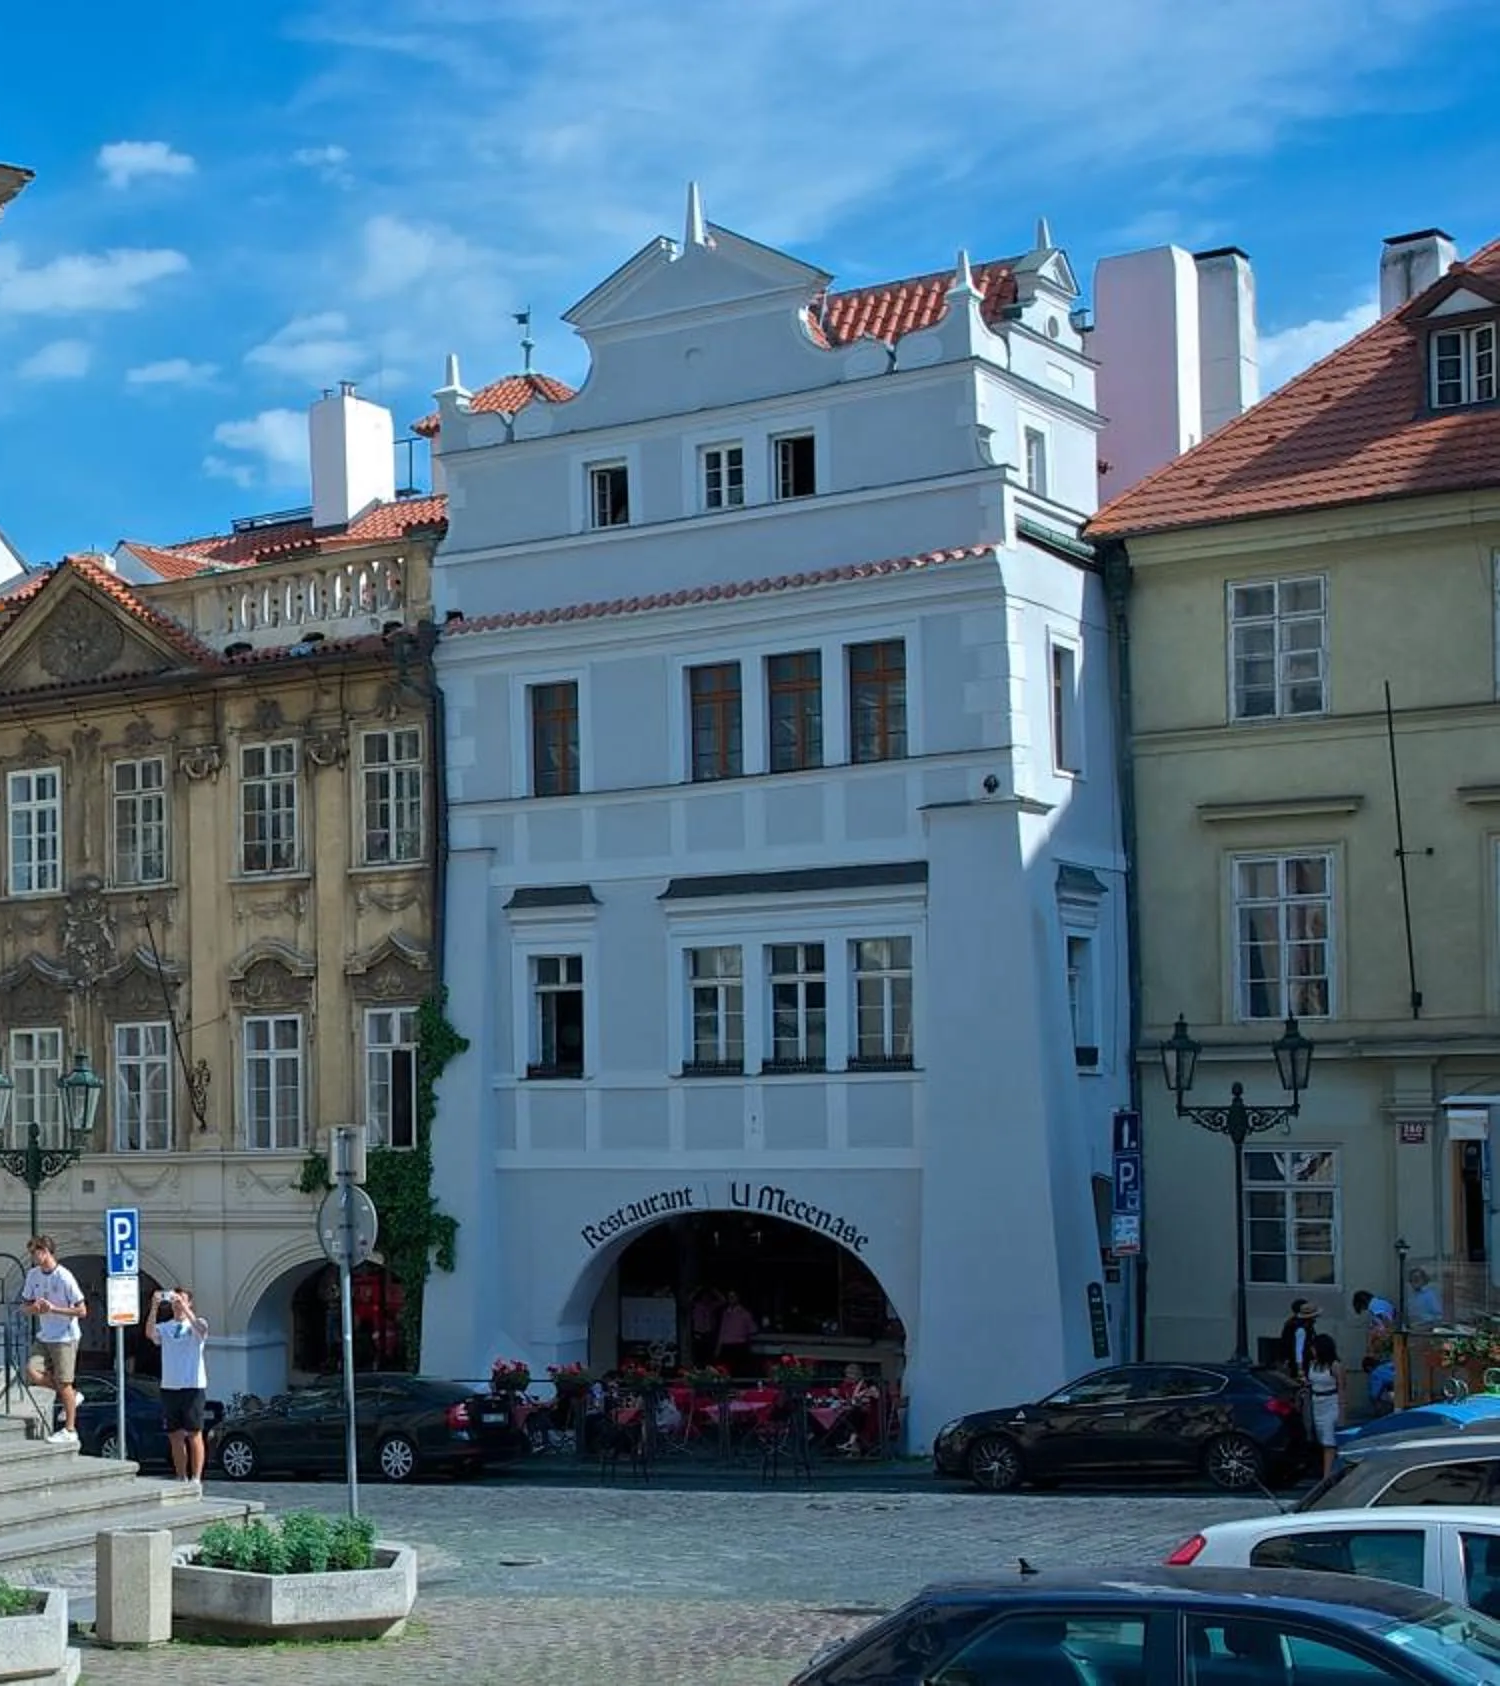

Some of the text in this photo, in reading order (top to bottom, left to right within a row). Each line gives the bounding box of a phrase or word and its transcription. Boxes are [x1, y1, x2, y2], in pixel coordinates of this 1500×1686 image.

[1120, 1162, 1135, 1195] P
[581, 1185, 693, 1249] Restaurant
[731, 1182, 750, 1207] U
[113, 1217, 132, 1255] P
